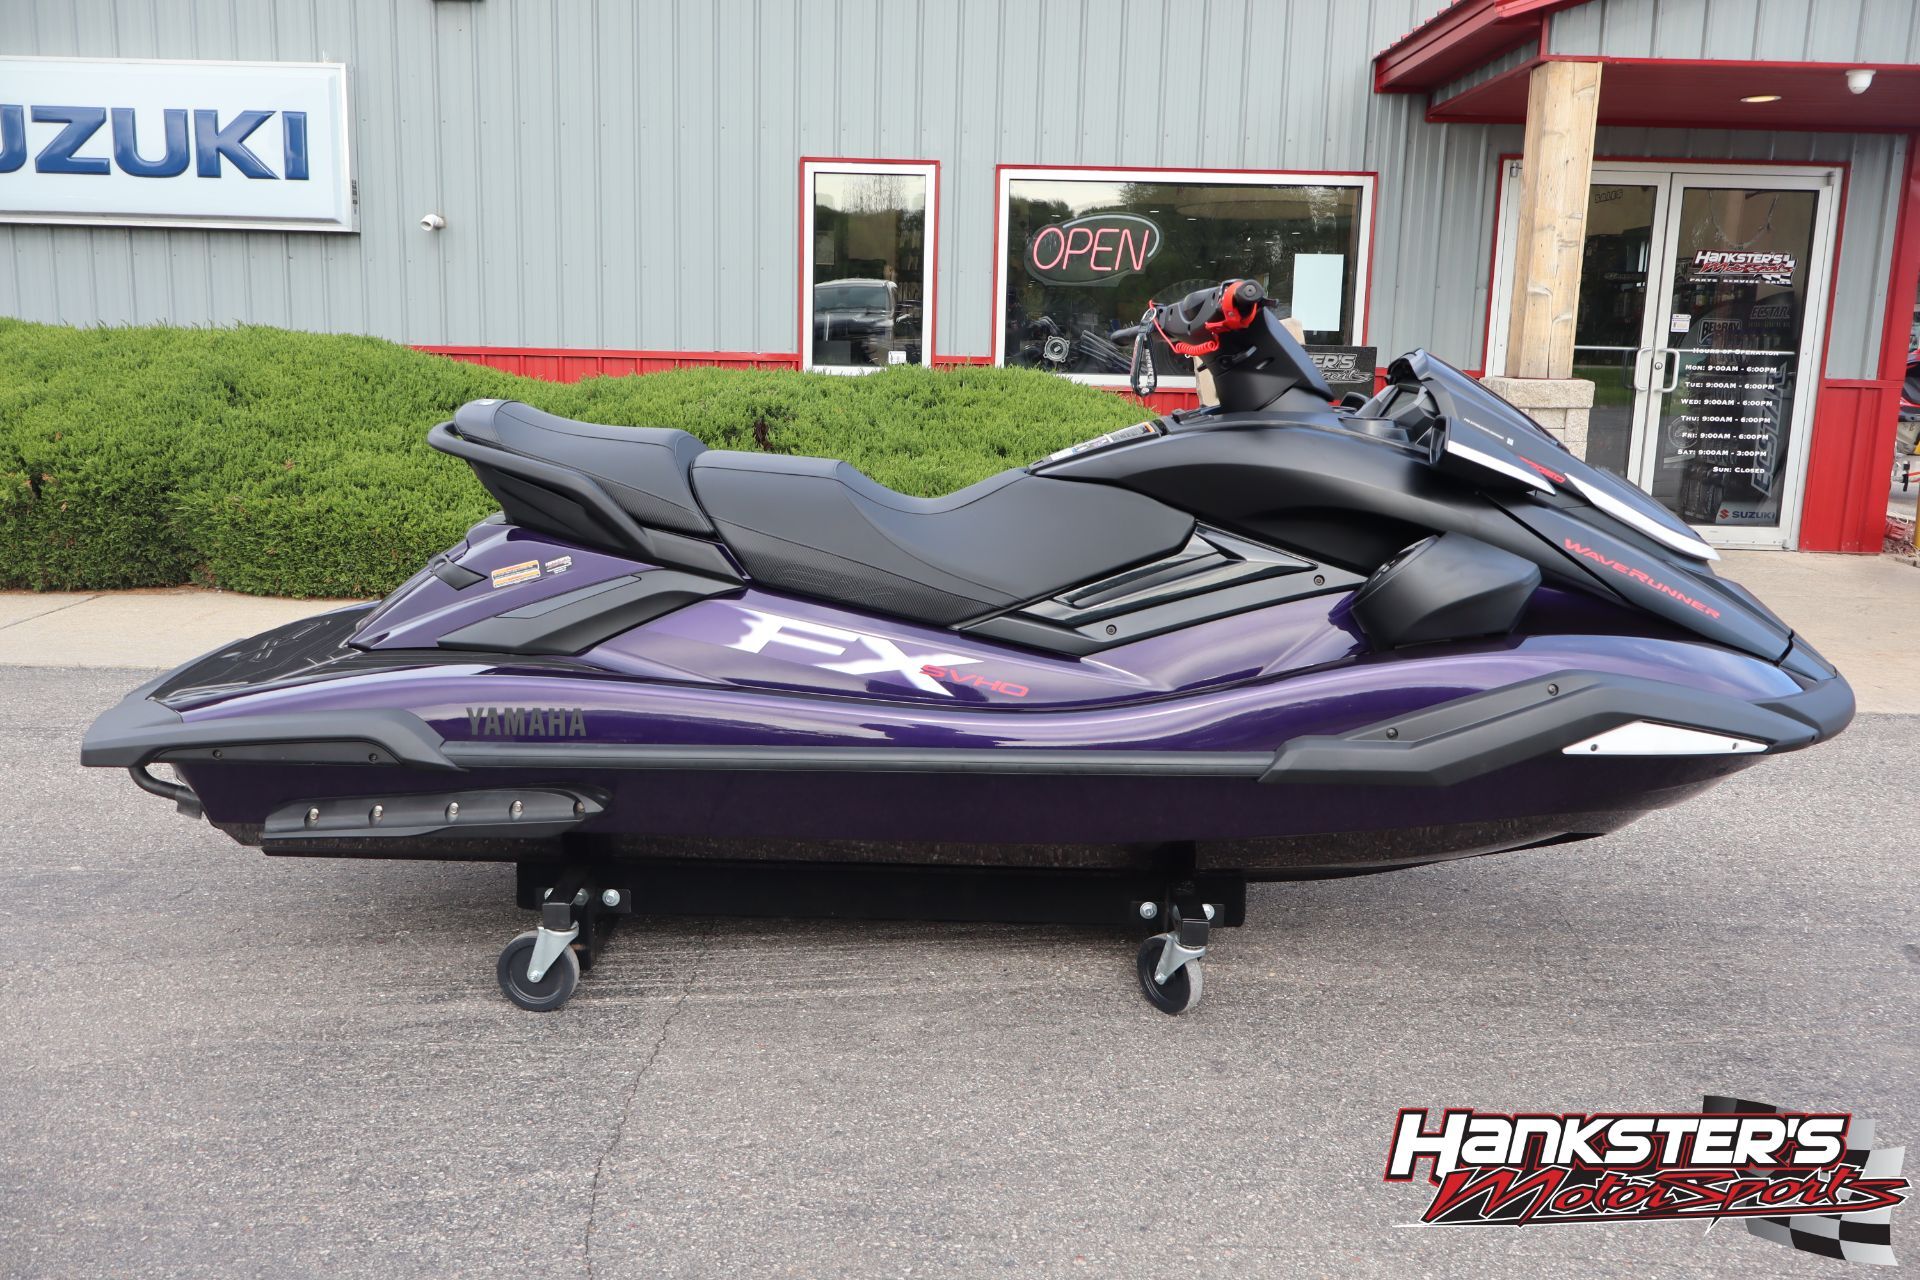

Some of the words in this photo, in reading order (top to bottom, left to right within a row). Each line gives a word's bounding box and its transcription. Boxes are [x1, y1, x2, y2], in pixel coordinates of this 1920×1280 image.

[1032, 226, 1150, 271] OPEN
[1732, 510, 1775, 519] SUZUKI
[725, 606, 985, 698] FX
[919, 664, 1030, 697] SVHO
[466, 707, 587, 737] YAMAHA
